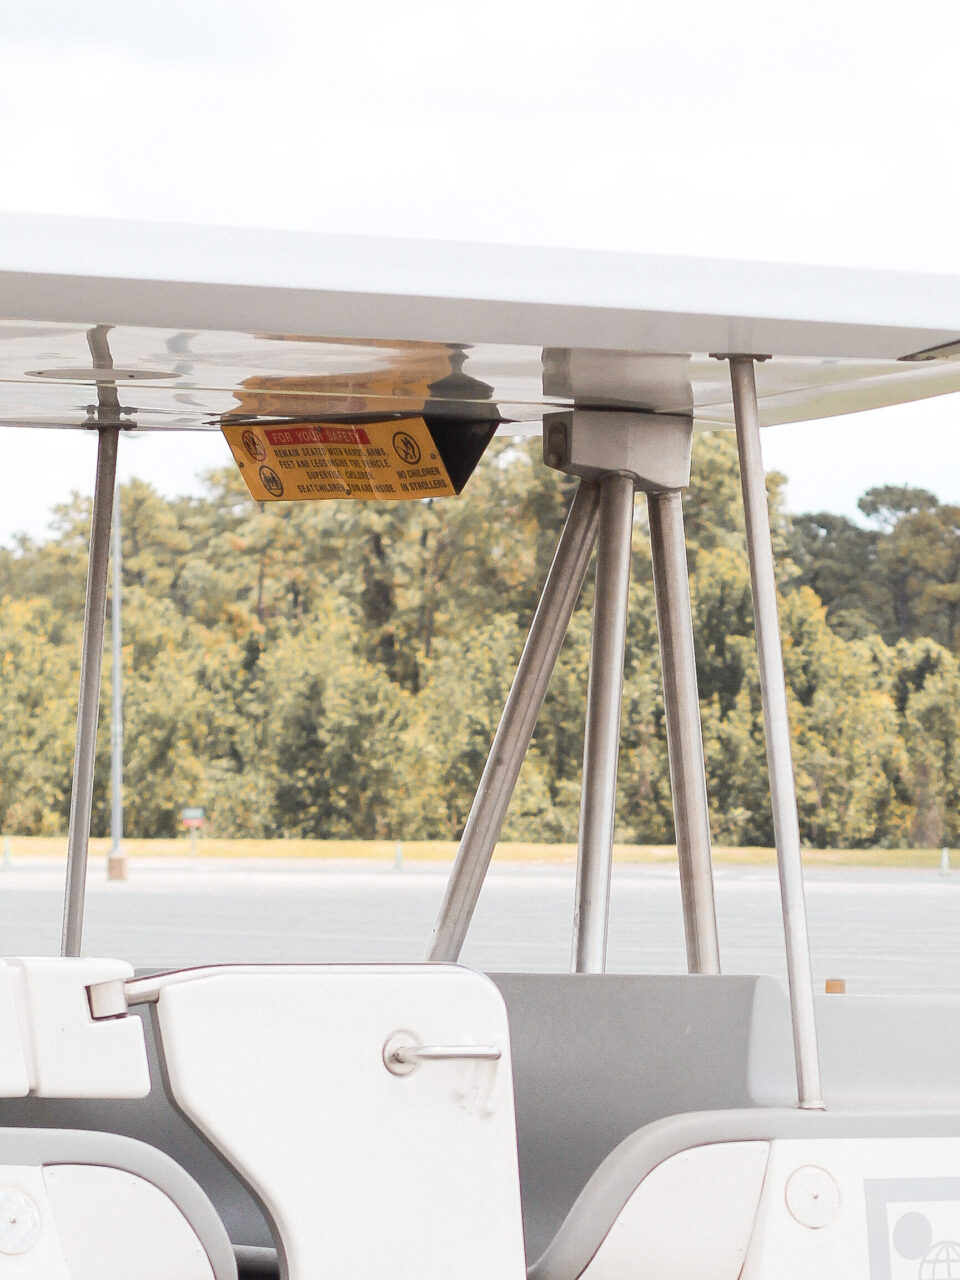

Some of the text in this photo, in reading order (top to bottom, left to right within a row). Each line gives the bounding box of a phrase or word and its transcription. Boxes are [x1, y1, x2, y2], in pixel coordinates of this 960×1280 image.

[271, 430, 359, 443] FOR YOUR SAFETY
[274, 448, 300, 458] REMAIN
[301, 447, 327, 457] SEATED
[327, 447, 344, 456] WITH
[278, 460, 296, 469] FEET
[296, 459, 311, 469] AND
[311, 459, 329, 468] LEGS
[329, 459, 349, 468] NSIDE
[348, 459, 361, 468] THE
[306, 470, 342, 480] SUPERVISE
[396, 466, 441, 479] NO CHILDREN
[297, 484, 314, 493] SEAT
[400, 482, 409, 492] IN
